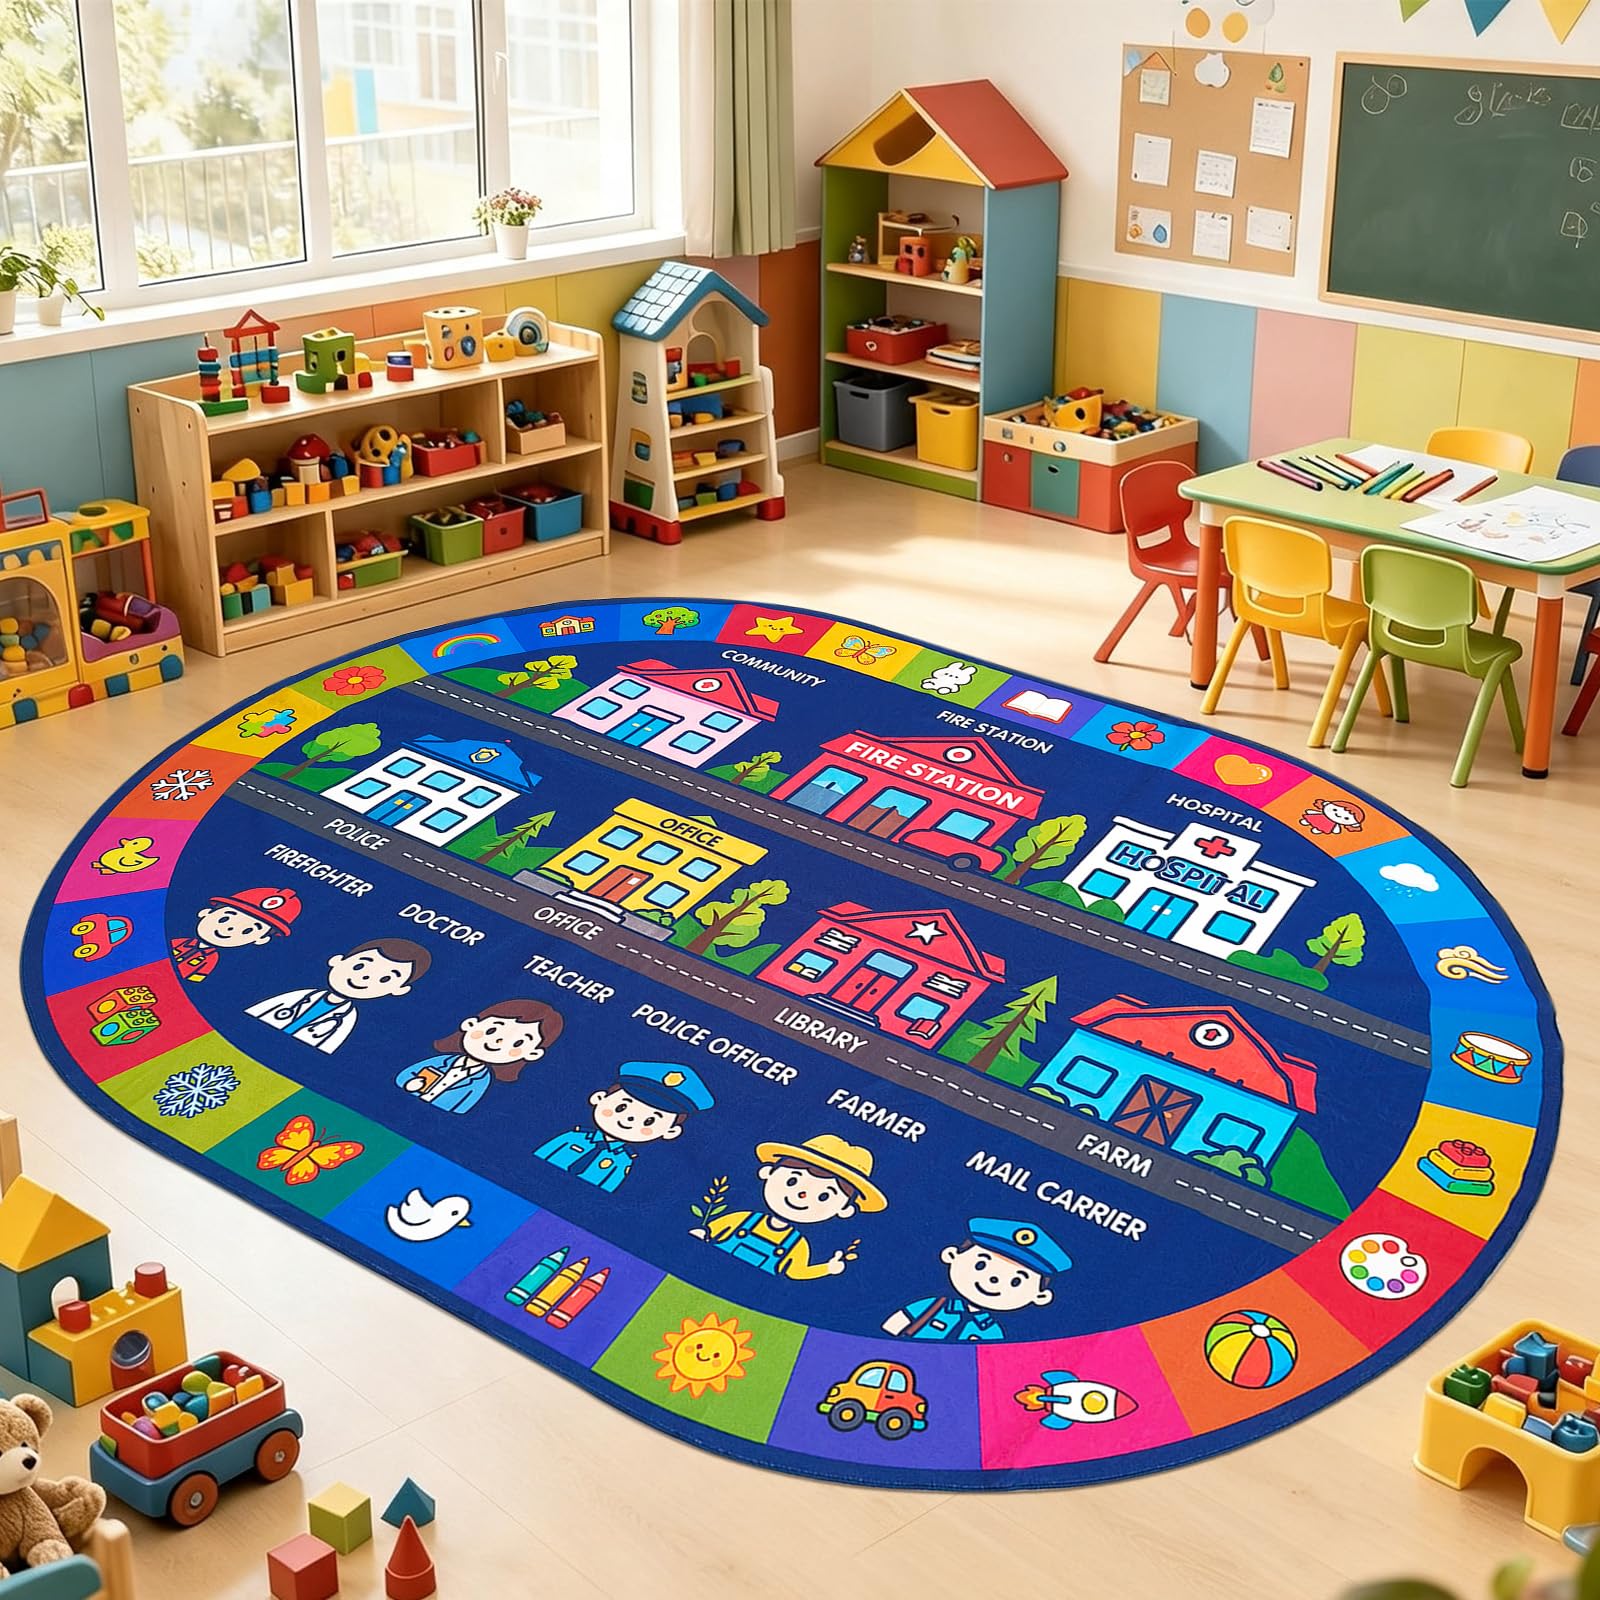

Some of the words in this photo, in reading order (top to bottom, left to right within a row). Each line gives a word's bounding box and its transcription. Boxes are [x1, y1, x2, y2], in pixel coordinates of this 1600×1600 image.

[721, 649, 826, 687] COMMUNITY
[936, 710, 975, 733] FIRE
[974, 721, 1054, 755] STATION
[844, 741, 907, 771] FIRE
[905, 761, 1025, 810] STATION
[323, 818, 390, 851] POLICE
[659, 818, 723, 848] OFFICE
[1166, 793, 1264, 833] HOSPITAL
[264, 843, 374, 898] FIREFIGHTER
[1115, 845, 1265, 909] HOSPITAL
[398, 903, 486, 946] DOCTOR
[533, 906, 603, 941] OFFICE
[522, 954, 615, 1004] TEACHER
[631, 1003, 712, 1046] POLICE
[708, 1037, 799, 1086] OFFICER
[773, 1007, 869, 1053] LIBRARY
[826, 1088, 927, 1143] FARMER
[1076, 1133, 1153, 1177] FARM
[965, 1150, 1031, 1192] MAIL
[1036, 1181, 1148, 1241] CARRIER
